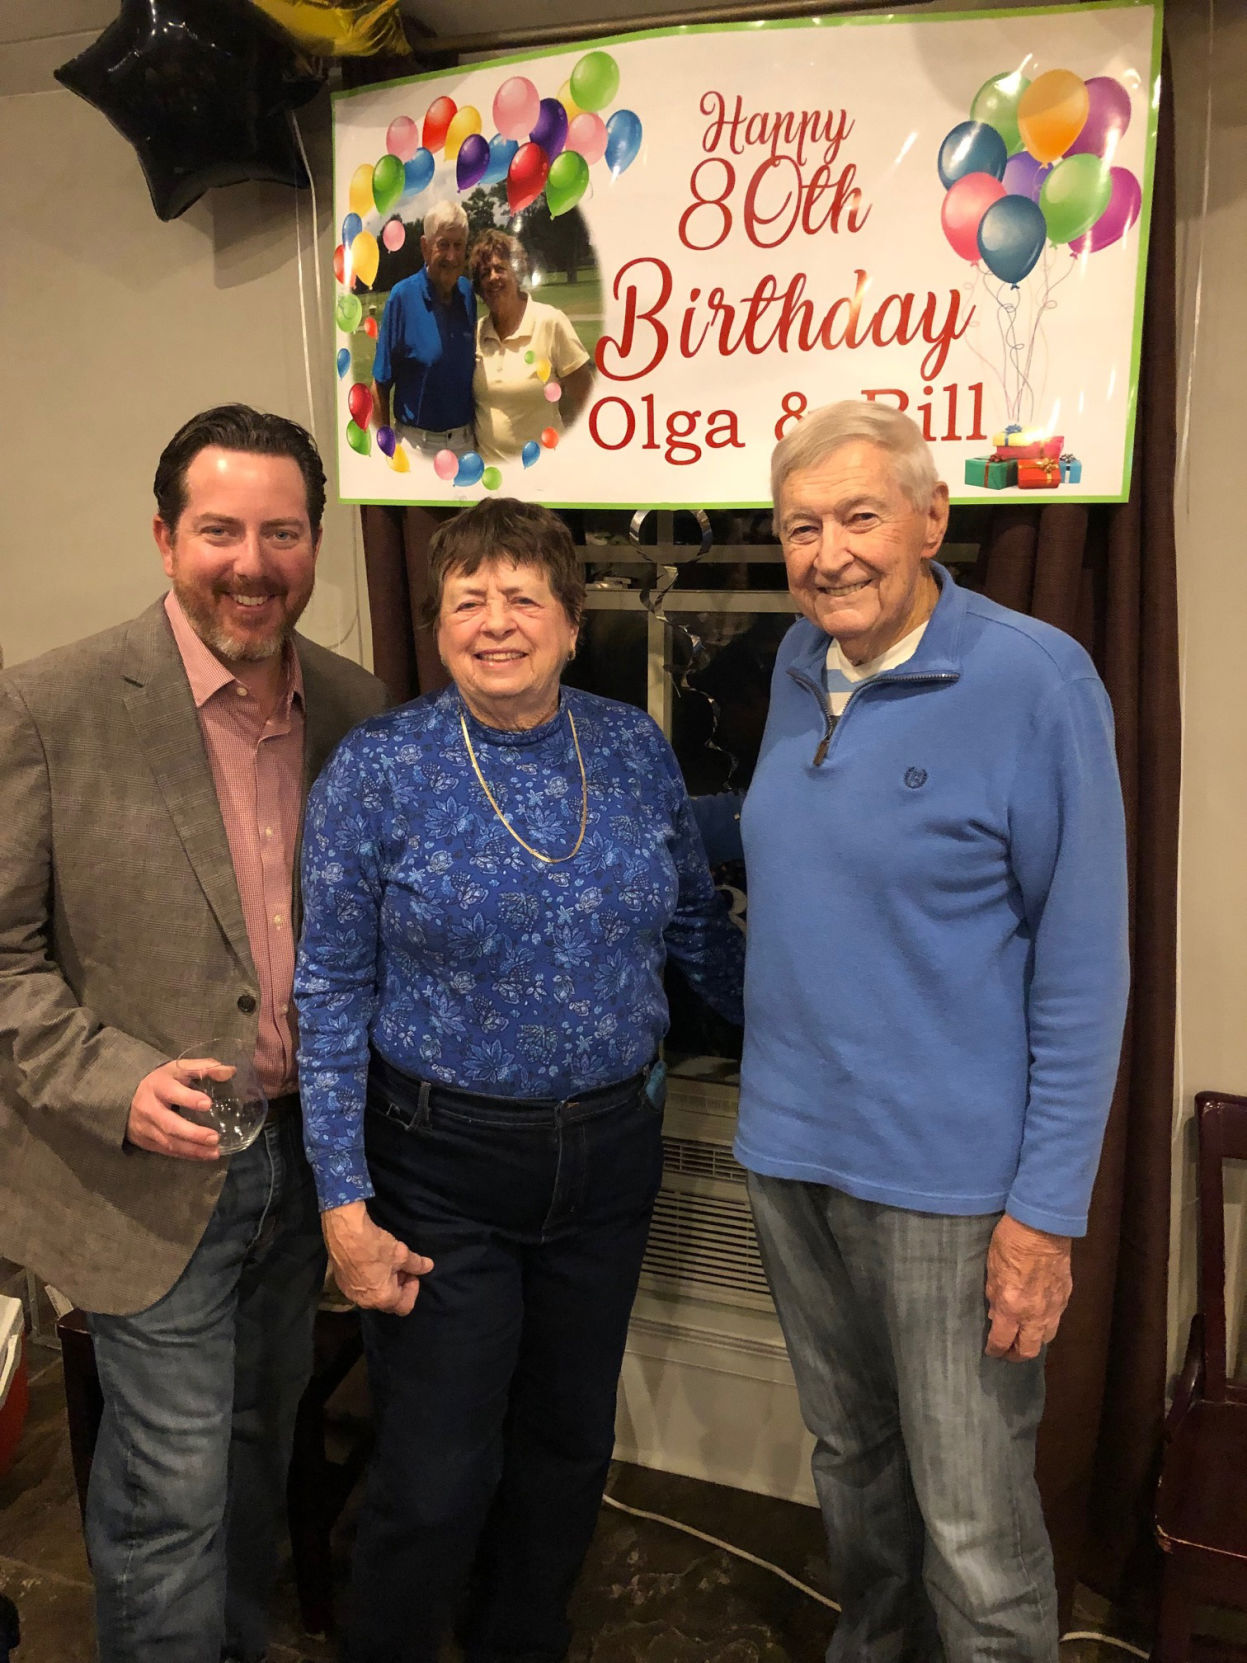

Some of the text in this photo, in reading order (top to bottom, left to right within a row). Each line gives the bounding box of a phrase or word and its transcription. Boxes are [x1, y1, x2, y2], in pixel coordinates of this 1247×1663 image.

[700, 91, 855, 166] Happy
[679, 155, 871, 250] 80th
[595, 257, 976, 381] Birthday
[589, 394, 745, 465] Olga
